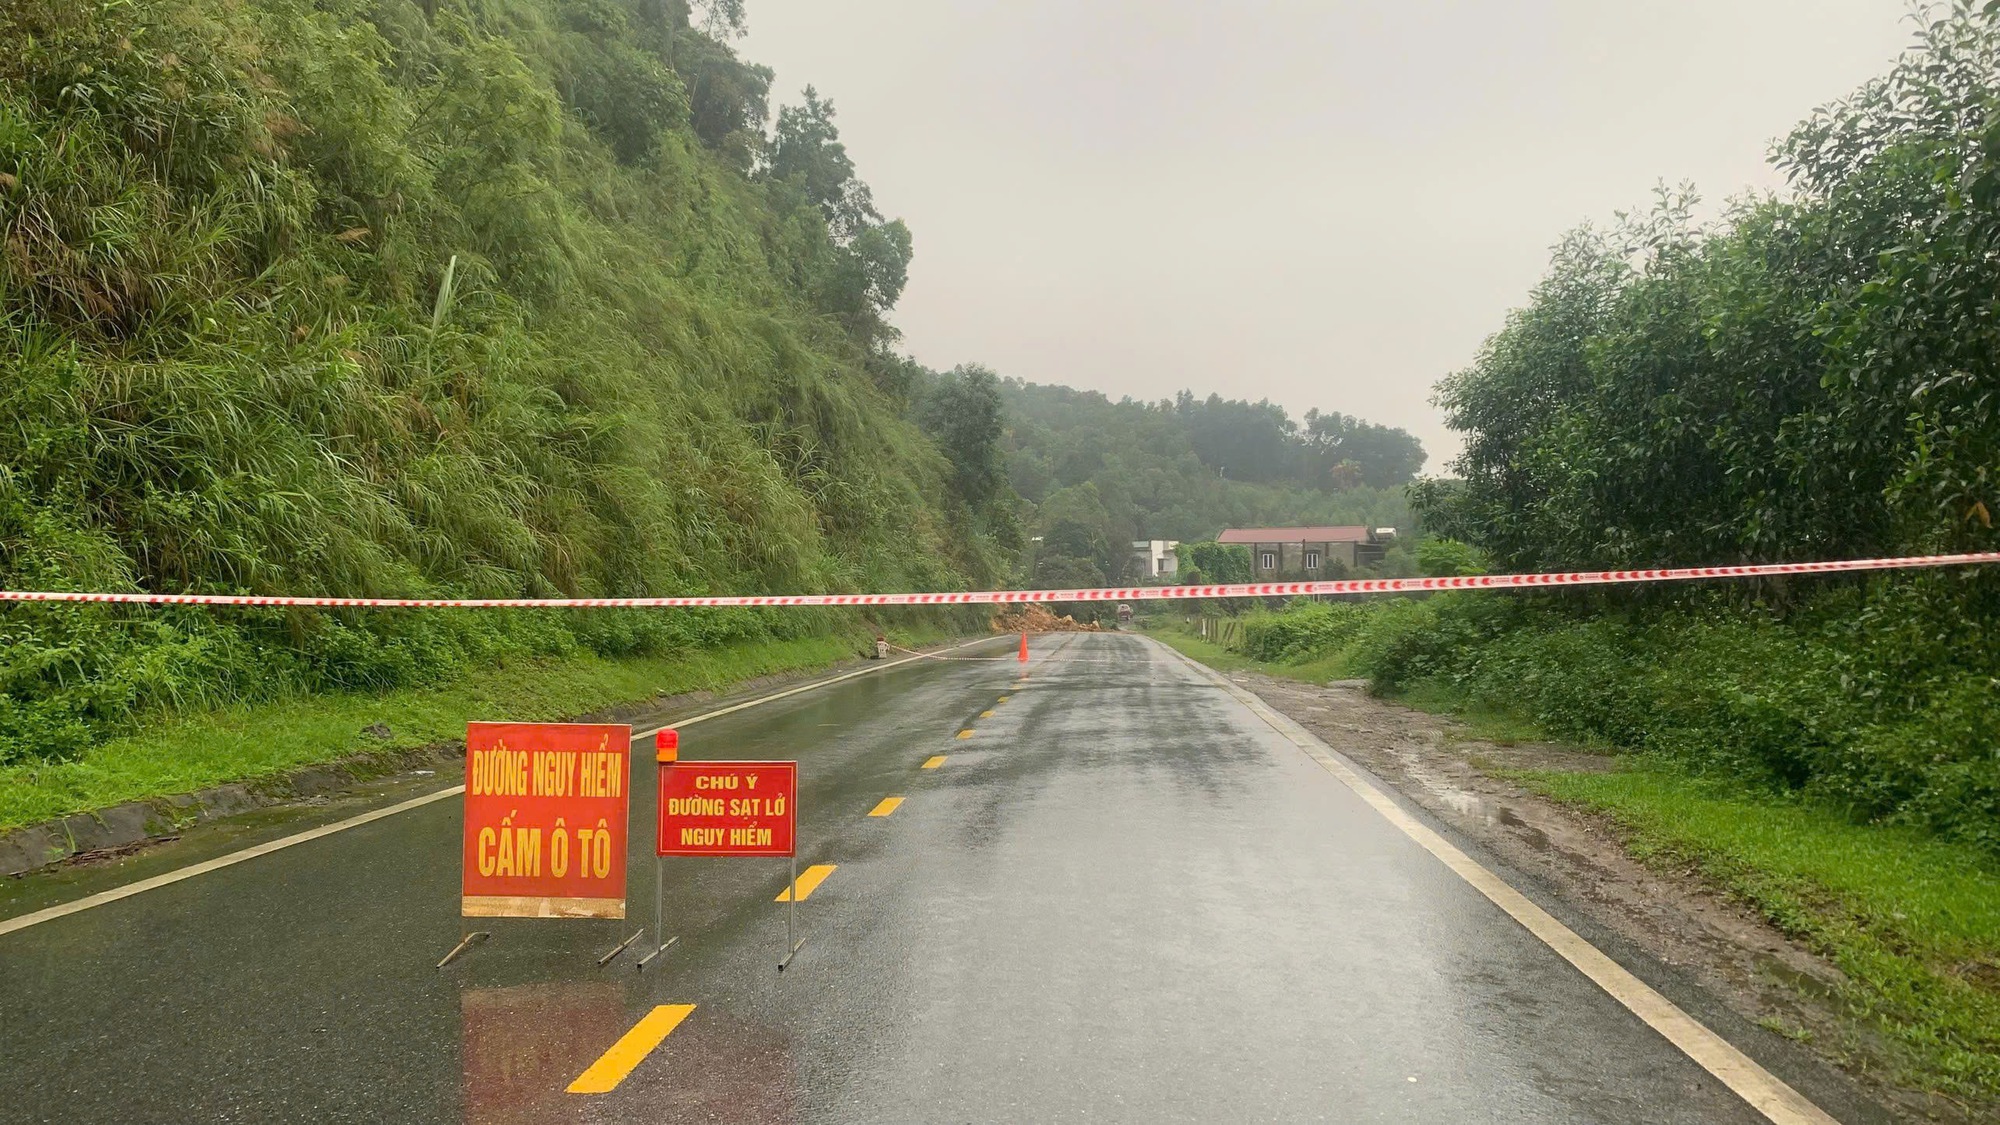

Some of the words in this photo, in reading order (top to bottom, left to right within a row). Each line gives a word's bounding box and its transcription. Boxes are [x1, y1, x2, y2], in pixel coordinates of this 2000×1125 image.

[472, 739, 528, 796] ĐƯỜNG
[532, 751, 577, 797] NGUY
[580, 733, 622, 798] HIỂM
[695, 773, 739, 790] CHÚ
[746, 773, 759, 790] Ý
[668, 794, 725, 816] ĐƯỜNG
[729, 798, 761, 820] SẠT
[765, 792, 786, 816] LỞ
[478, 809, 541, 877] CẤM
[550, 817, 569, 878] Ô
[577, 818, 611, 879] TÔ
[681, 828, 725, 846] NGUY
[730, 821, 772, 846] HIỂM
